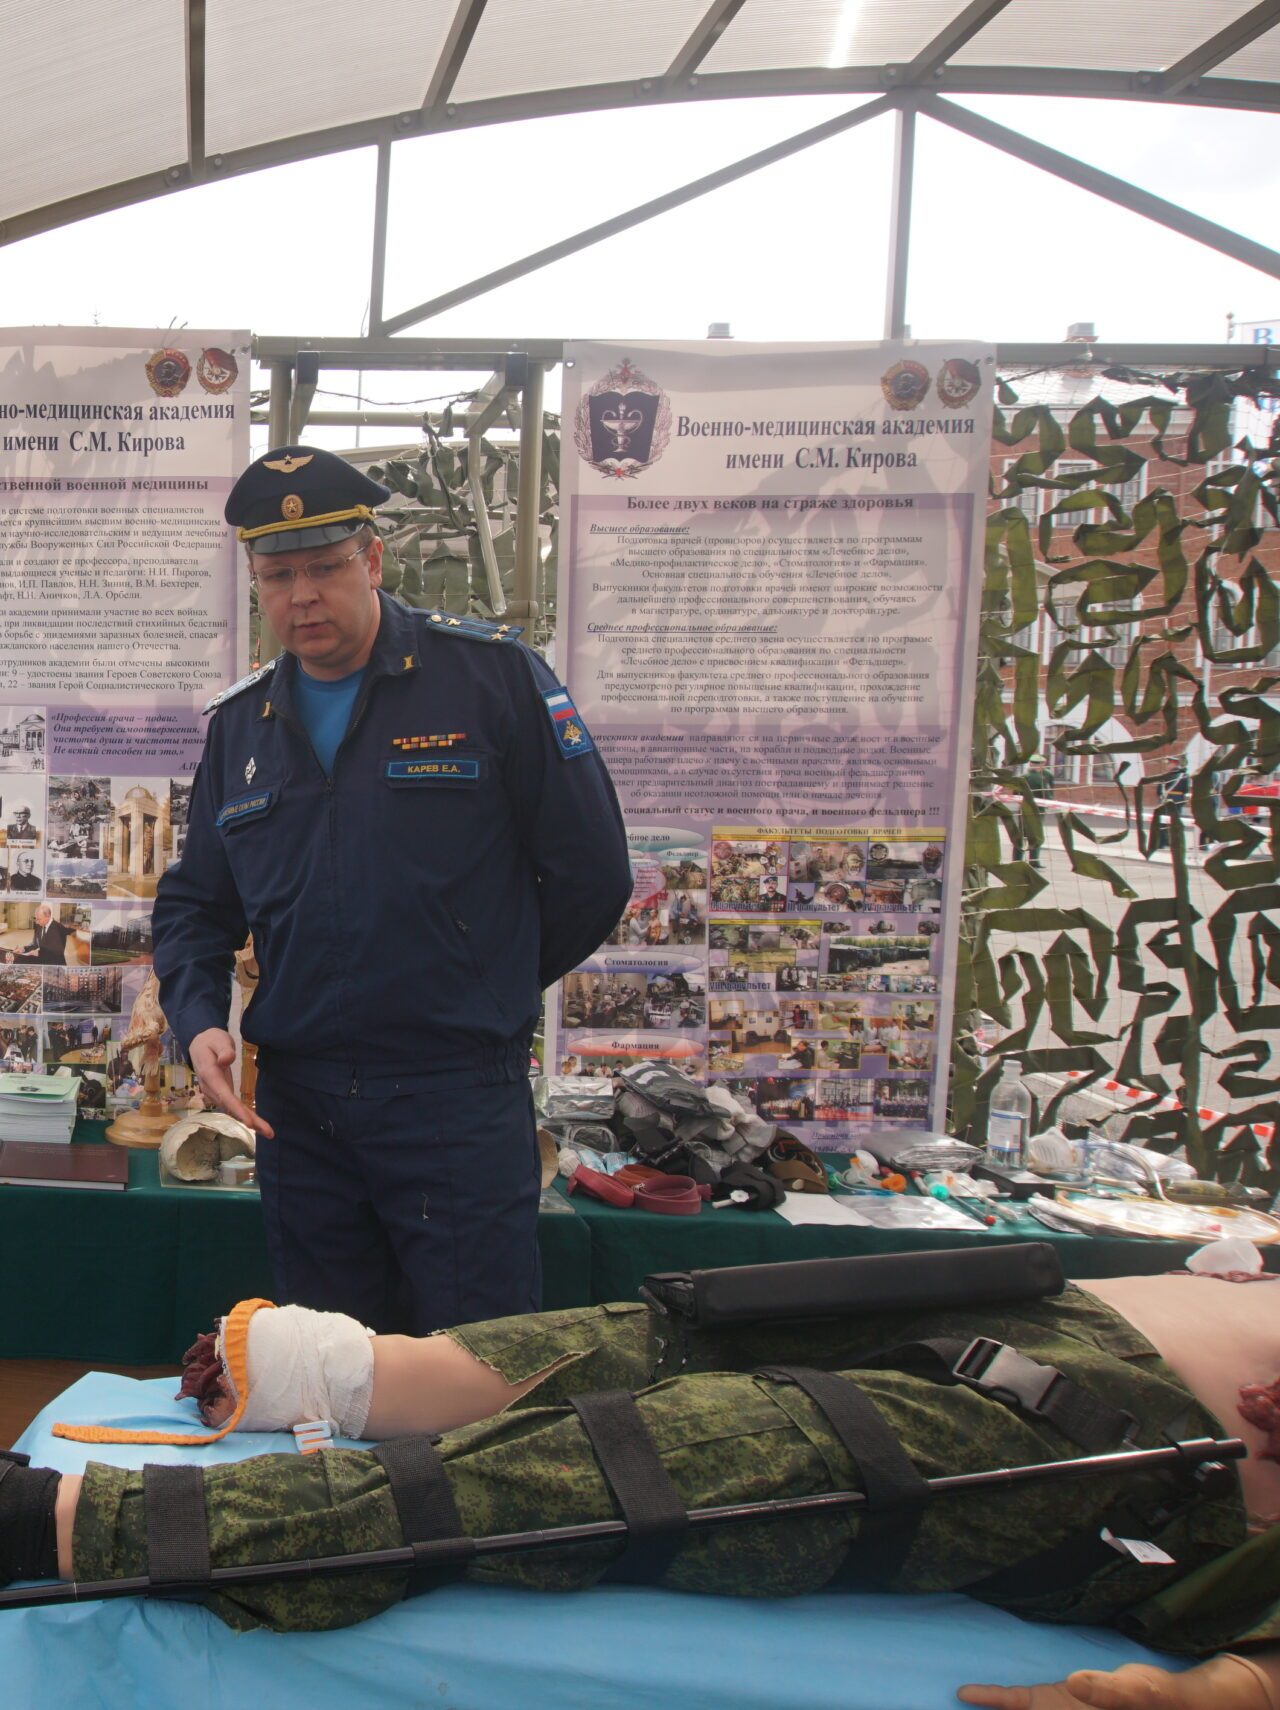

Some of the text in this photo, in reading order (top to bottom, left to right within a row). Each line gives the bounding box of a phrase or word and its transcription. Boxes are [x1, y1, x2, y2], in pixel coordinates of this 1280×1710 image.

[149, 403, 235, 422] академия
[677, 415, 975, 439] Военно-медицинская академия
[3, 430, 185, 456] имени С.М. Кирова
[726, 446, 917, 473] имени С.М. Кирова
[66, 477, 127, 490] военной
[131, 480, 209, 492] медицины
[627, 497, 913, 512] Более двух веков на страже здоровья
[590, 524, 690, 534] Высшее образование:
[30, 540, 93, 550] Вооруженных
[96, 540, 114, 548] Сил
[117, 539, 169, 547] Российской
[172, 539, 224, 549] Федерации.
[0, 570, 56, 578] выдающиеся
[59, 570, 92, 578] ученые
[102, 570, 145, 578] педагоги:
[148, 567, 169, 576] Н.И.
[171, 567, 212, 577] Пирогов,
[18, 579, 38, 587] И.П.
[40, 579, 76, 589] Павлов,
[78, 579, 99, 587] Н.Н.
[101, 579, 133, 589] Зинин,
[135, 579, 157, 587] В.М.
[159, 578, 202, 588] Бехтерев,
[17, 590, 36, 598] Н.Н.
[39, 590, 80, 600] Аничков,
[82, 590, 102, 598] Л.А.
[105, 590, 143, 600] Орбели.
[587, 623, 778, 632] Среднее профессиональное образование:
[48, 660, 89, 668] академии
[92, 658, 116, 666] были
[52, 713, 105, 722] «Профессия
[53, 724, 71, 732] Она
[73, 725, 113, 734] требует
[68, 746, 98, 754] всякий
[101, 746, 142, 754] способен
[179, 761, 198, 770] А.П
[407, 764, 461, 773] КАРЕВ Е.А.
[623, 805, 681, 815] социальный
[775, 808, 808, 816] врача,
[868, 807, 926, 817] фельдшера
[928, 807, 940, 815] !!!
[627, 833, 670, 842] бное дело
[756, 828, 812, 836] ФАКУЛЬТЕТЫ
[815, 828, 869, 836] ПОДГОТОВКИ
[604, 957, 669, 968] Стоматология
[612, 1040, 660, 1051] Фармация
